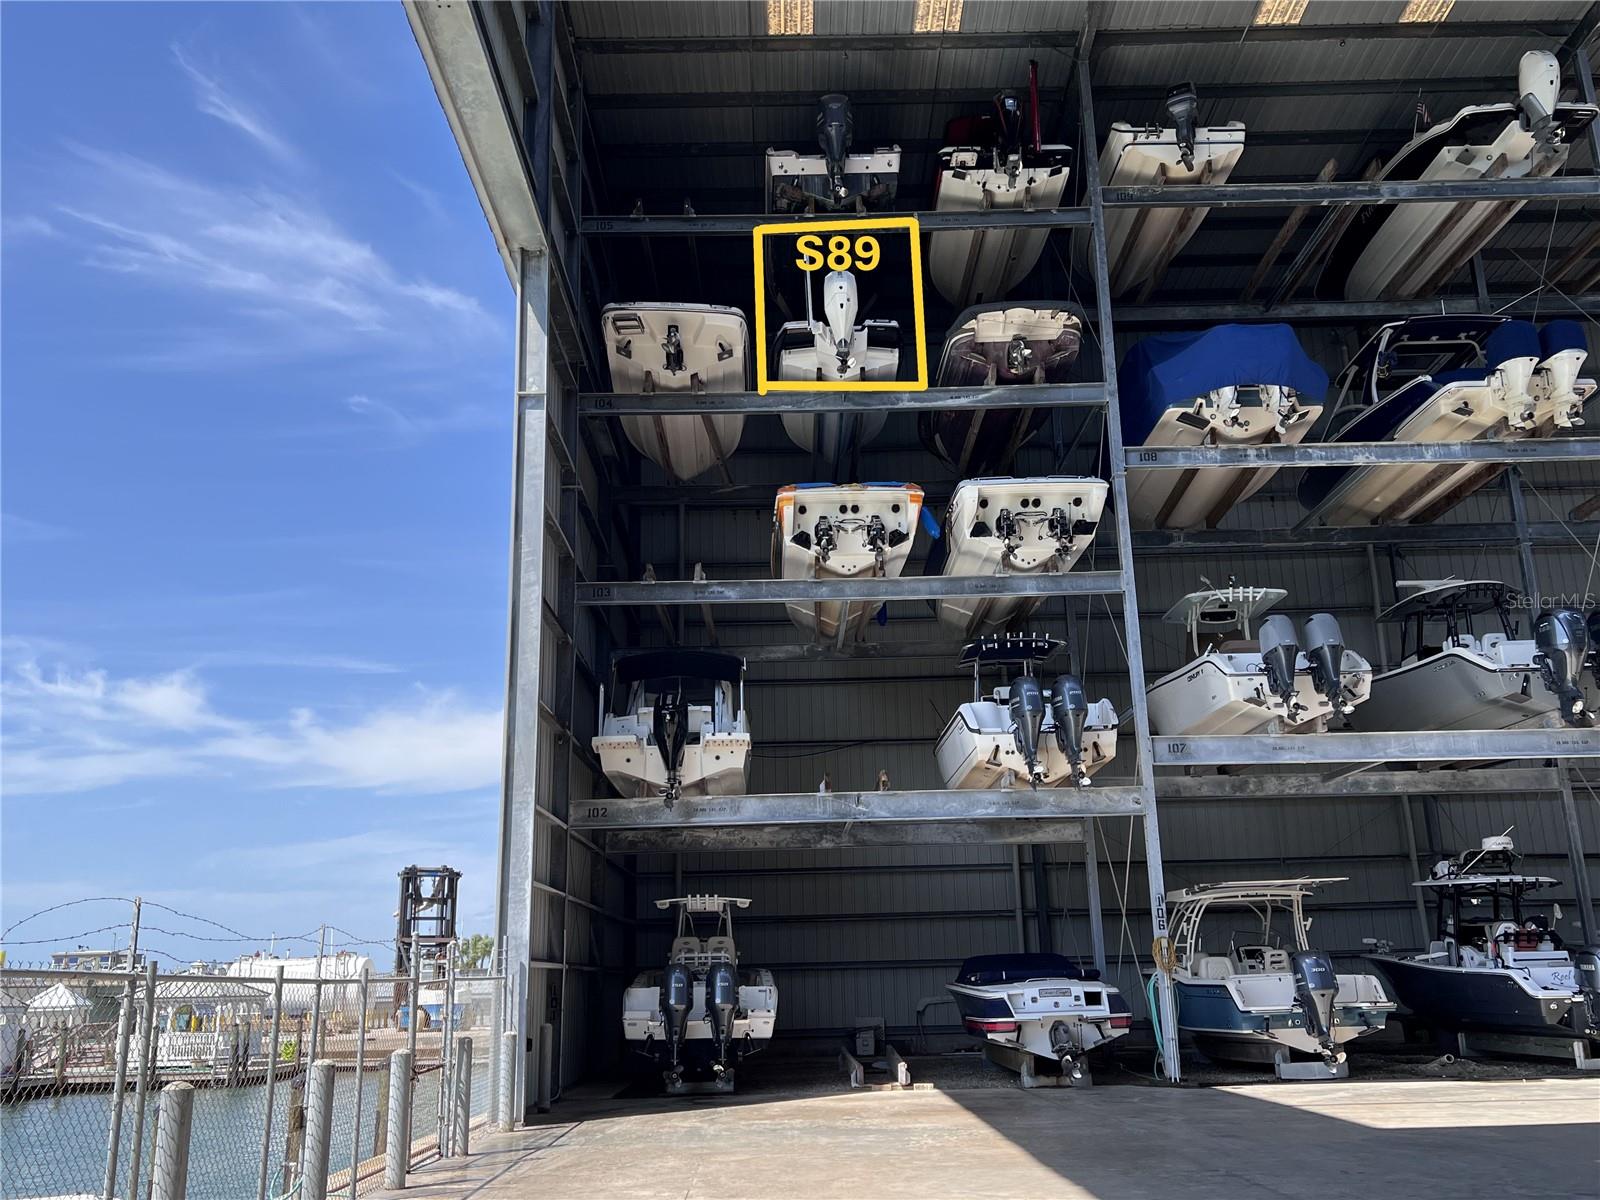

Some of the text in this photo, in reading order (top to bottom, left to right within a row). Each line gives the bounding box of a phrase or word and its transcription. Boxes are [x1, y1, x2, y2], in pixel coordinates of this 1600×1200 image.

[596, 221, 613, 231] 105
[594, 399, 613, 409] 104
[1139, 452, 1158, 461] 108
[592, 587, 611, 598] 103
[1167, 743, 1187, 753] 107
[587, 807, 608, 818] 102
[1156, 895, 1166, 931] 106
